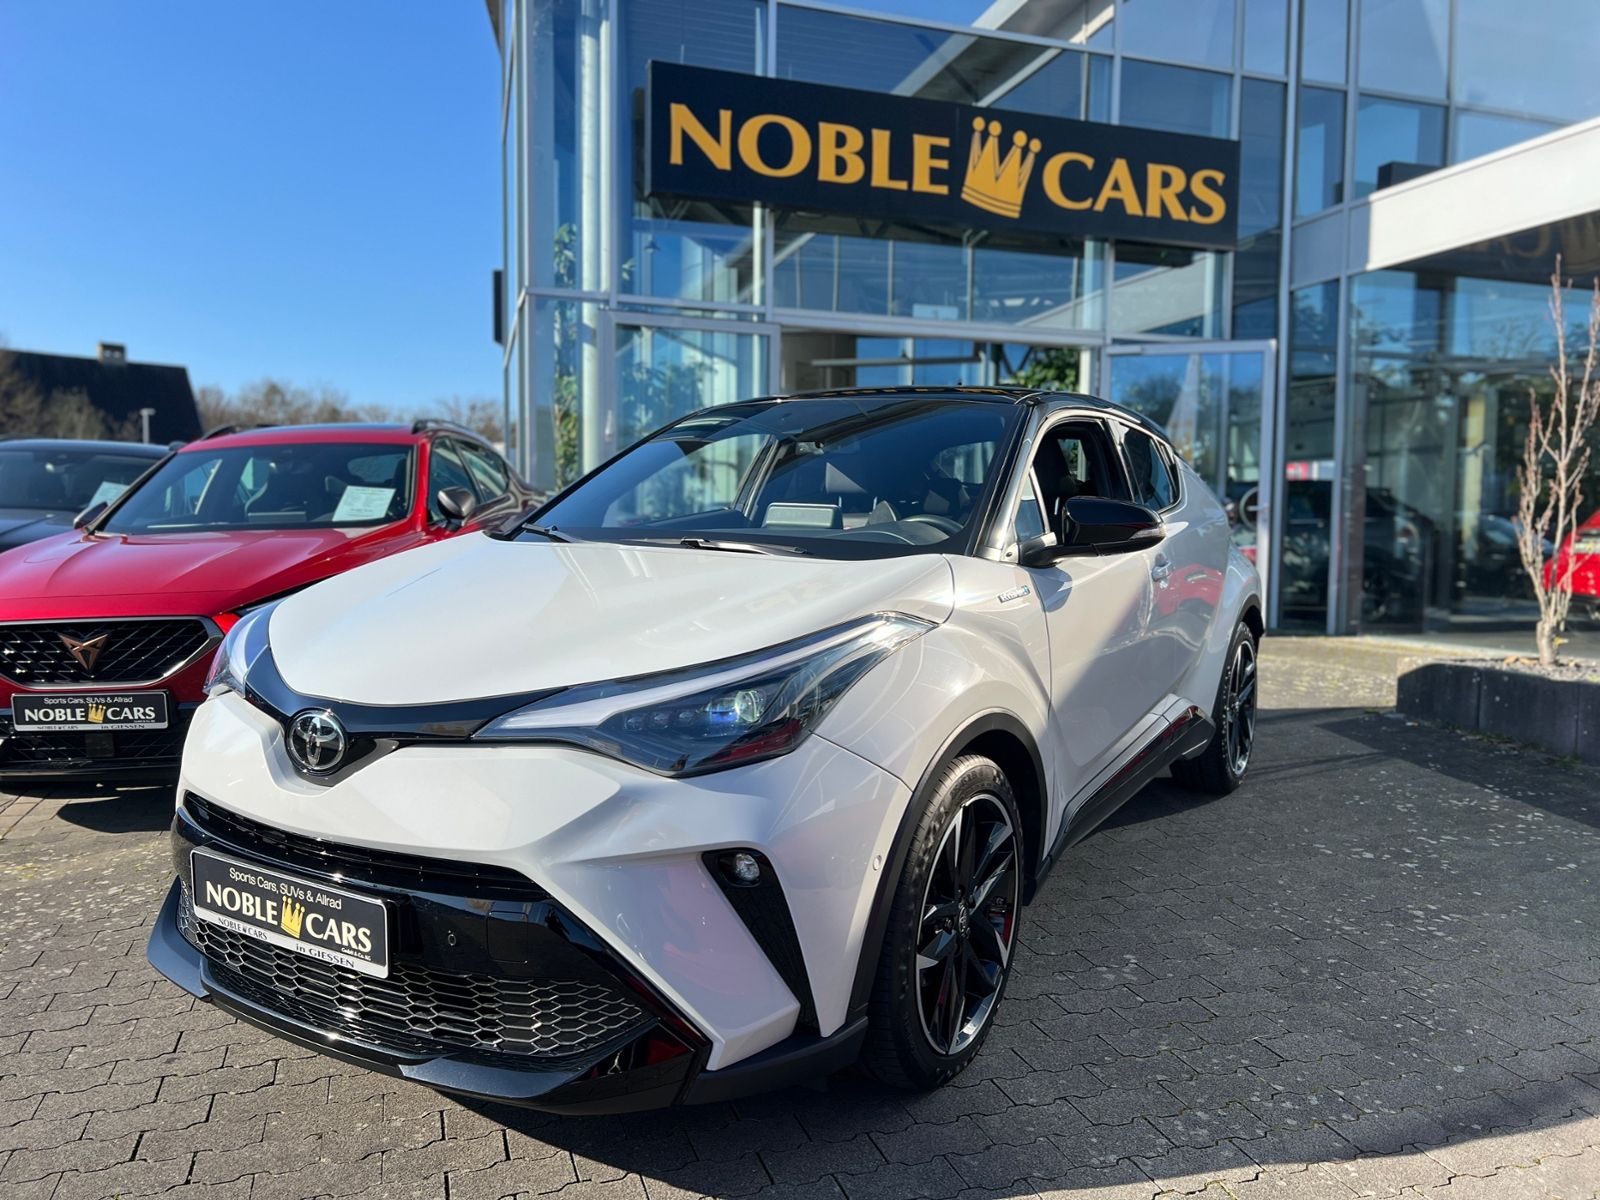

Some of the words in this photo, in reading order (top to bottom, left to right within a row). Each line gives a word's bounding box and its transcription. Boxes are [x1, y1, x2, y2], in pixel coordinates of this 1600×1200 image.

[668, 101, 951, 196] NOBLE
[1041, 151, 1227, 225] CARS
[24, 707, 86, 722] NOBLE
[106, 706, 156, 721] CARS
[43, 697, 67, 706] Sports
[113, 696, 133, 704] Allrad
[229, 867, 256, 886] Sports
[257, 876, 279, 894] Cars,
[279, 882, 305, 900] SUVs
[306, 890, 314, 903] &
[315, 892, 342, 910] Allrad
[205, 880, 278, 926] NOBLE
[305, 912, 372, 953] CARS
[217, 917, 242, 932] NOBLE
[246, 926, 268, 941] CARS
[296, 943, 305, 952] in
[308, 949, 355, 969] GIESSEN
